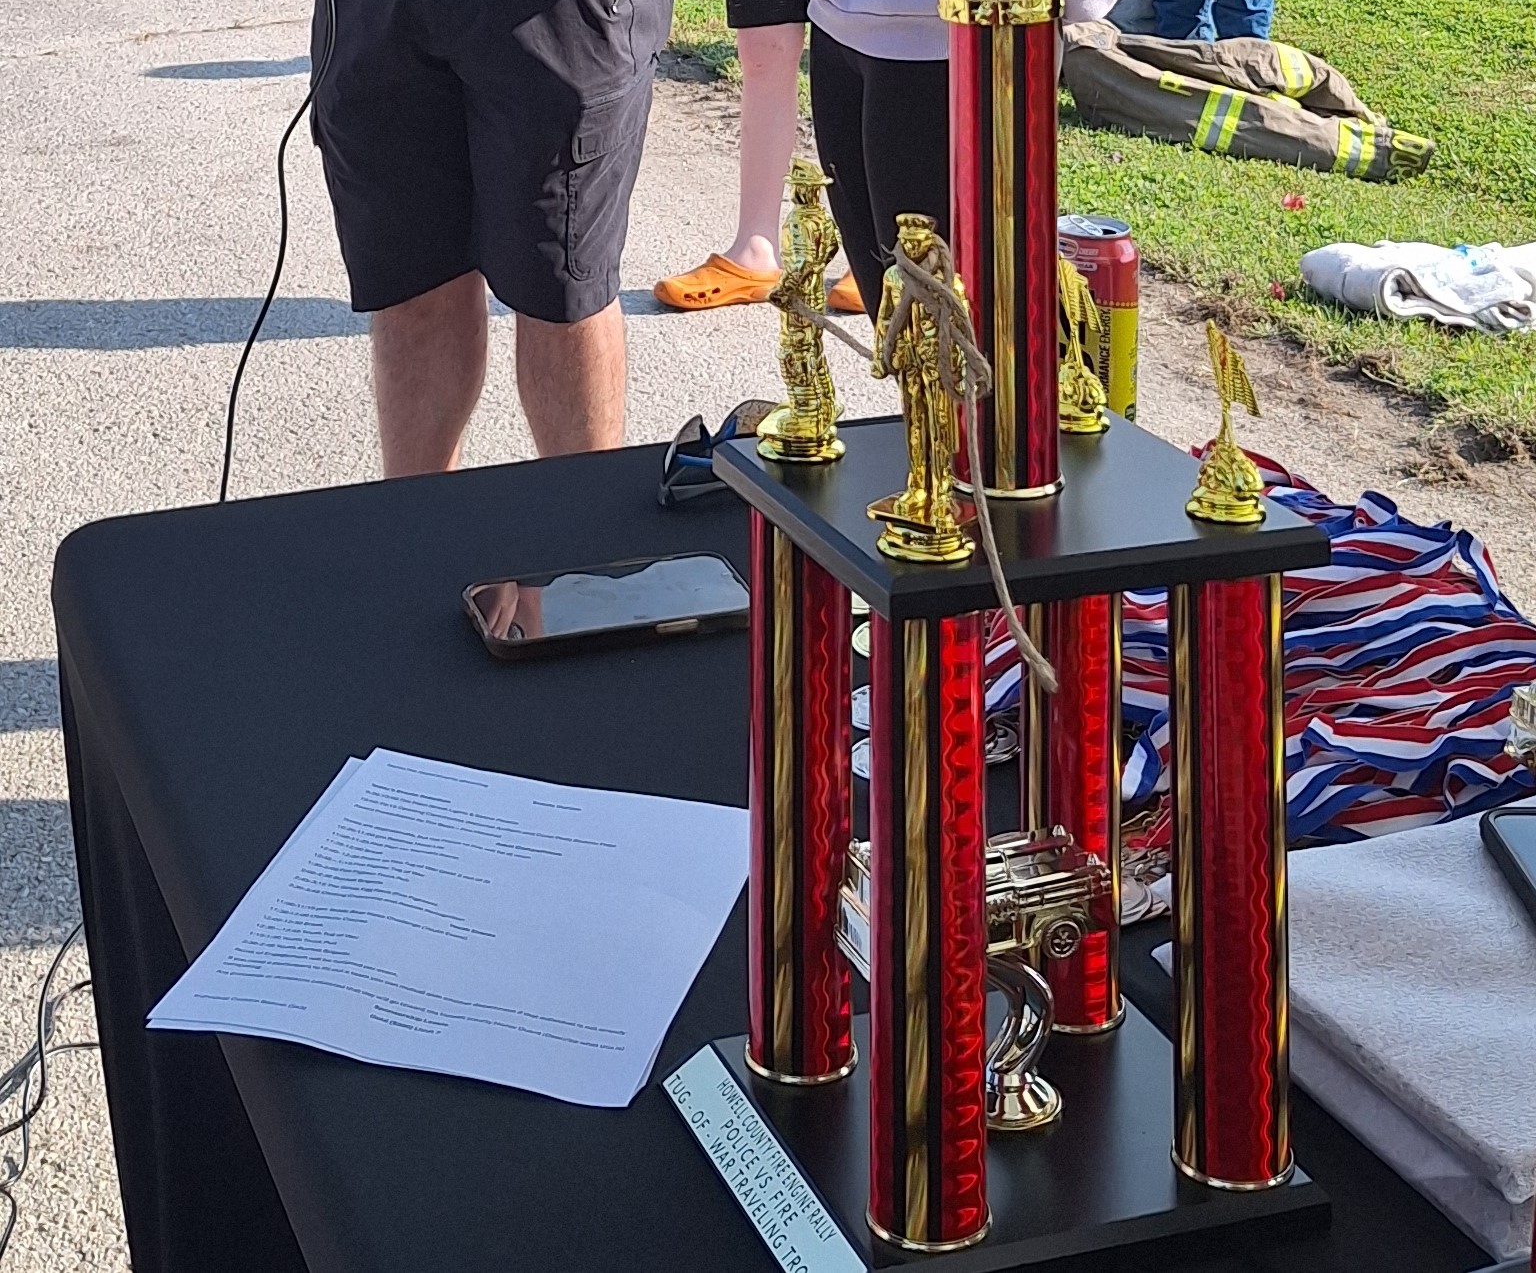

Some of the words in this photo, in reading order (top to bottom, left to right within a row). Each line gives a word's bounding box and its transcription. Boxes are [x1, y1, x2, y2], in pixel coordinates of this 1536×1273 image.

[668, 1074, 691, 1104] TUG
[692, 1111, 710, 1129] OF
[710, 1137, 735, 1172] WAR
[730, 1169, 787, 1249] TRAVELING
[717, 1079, 748, 1119] HOWELL
[742, 1115, 775, 1154] COUNTY
[770, 1151, 790, 1177] FIRE
[782, 1172, 815, 1213] ENGINE
[808, 1208, 836, 1242] RALLY
[720, 1119, 760, 1170] POLICE
[754, 1167, 772, 1193] VS.
[769, 1190, 798, 1227] FIRE
